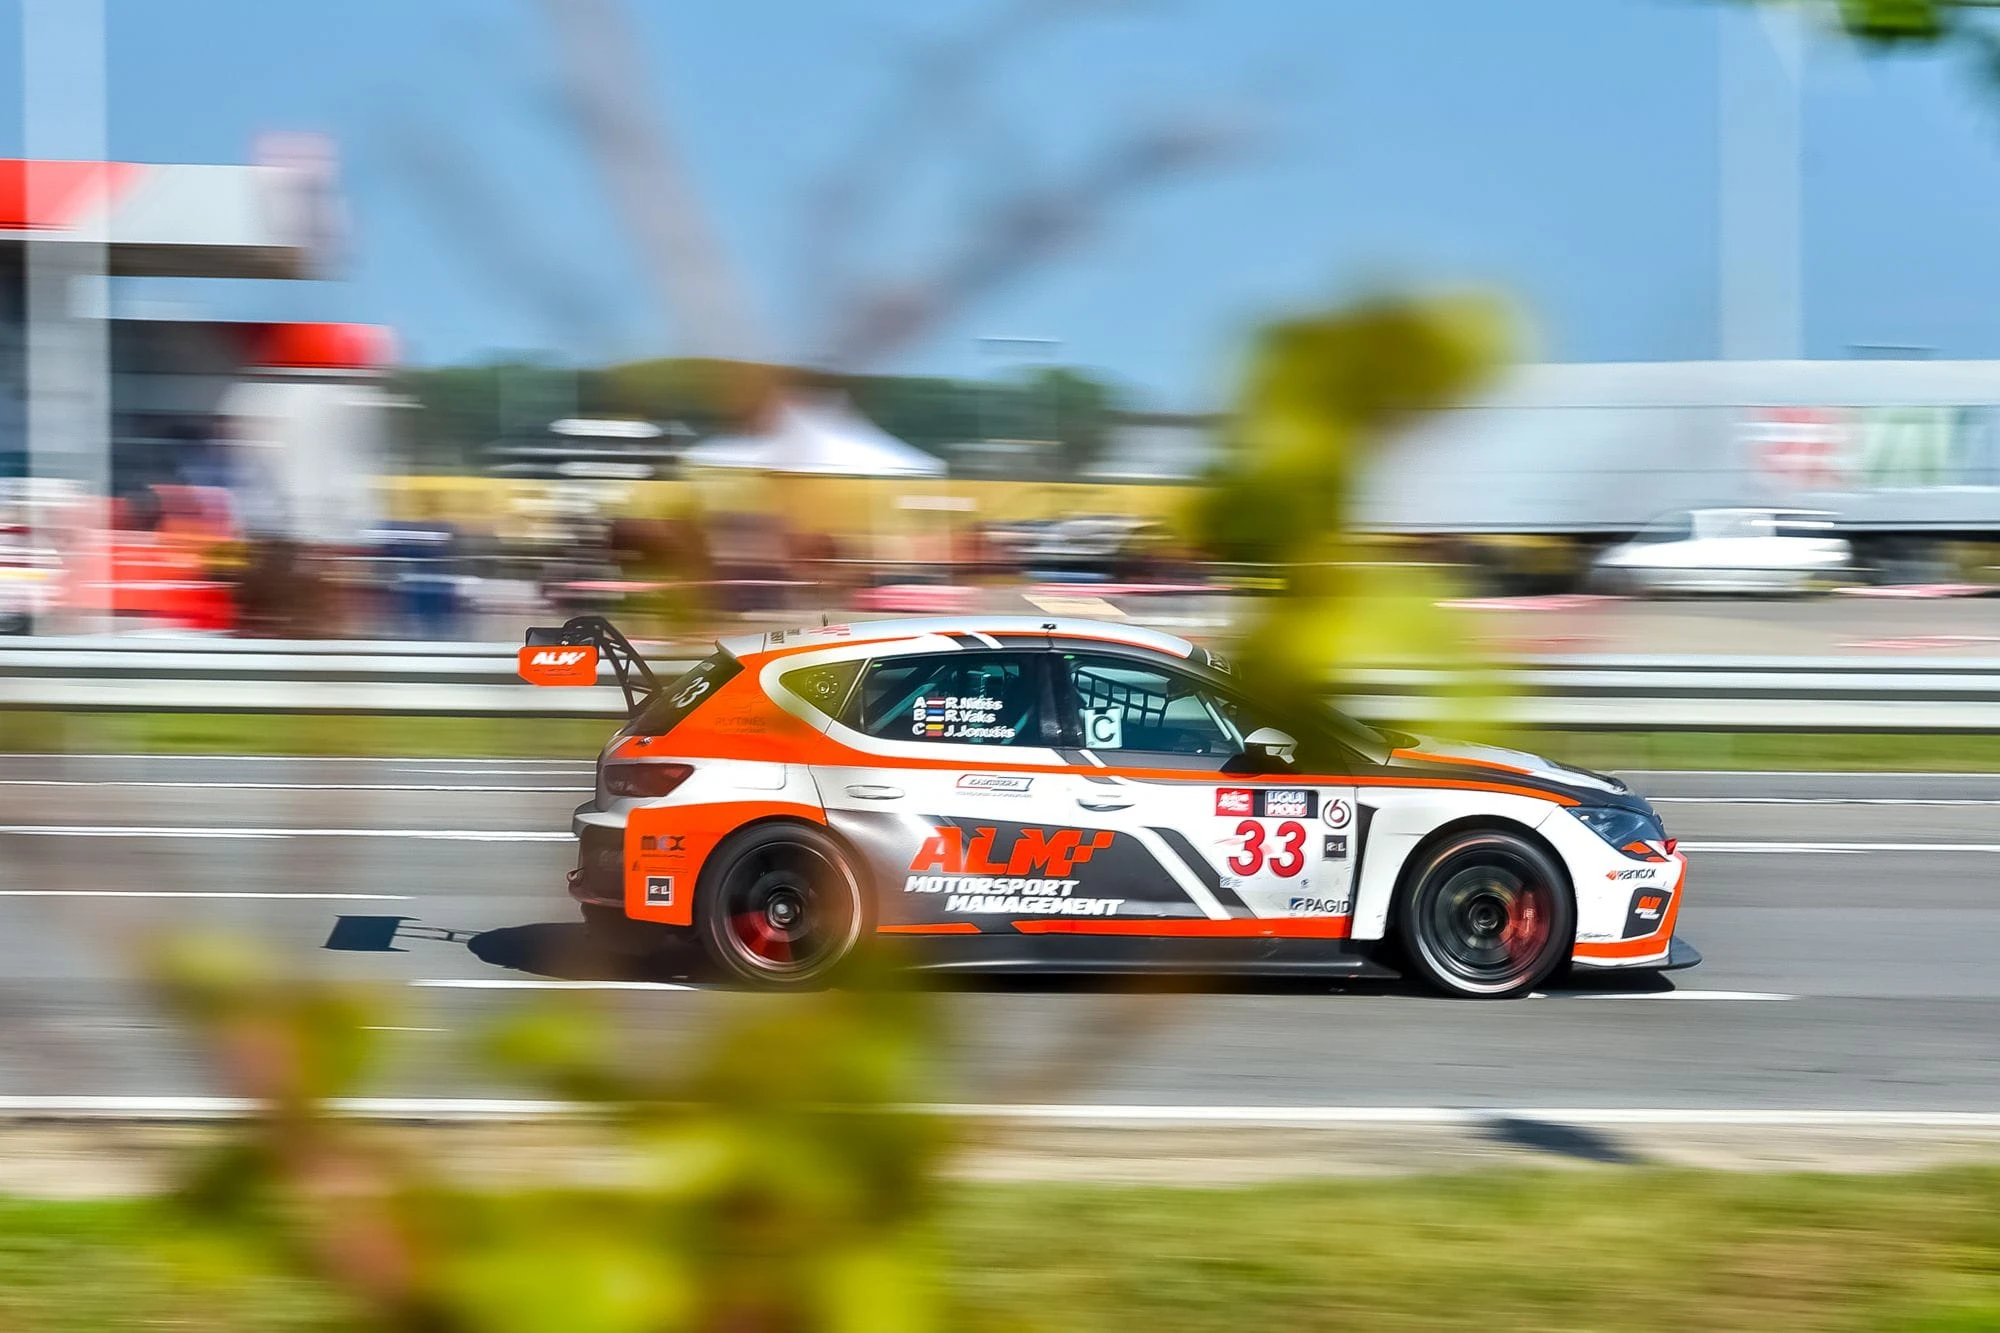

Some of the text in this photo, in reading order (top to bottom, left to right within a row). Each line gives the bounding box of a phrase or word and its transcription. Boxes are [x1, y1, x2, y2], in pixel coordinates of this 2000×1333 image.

[912, 696, 927, 709] A
[913, 709, 927, 721] B
[912, 722, 926, 736] C
[1093, 715, 1114, 742] C
[909, 826, 1083, 877] ALM
[1228, 819, 1306, 878] 33
[904, 876, 1080, 897] MOTORSPORT
[945, 894, 1125, 916] MANAGEMENT
[1305, 898, 1351, 913] PAGID
